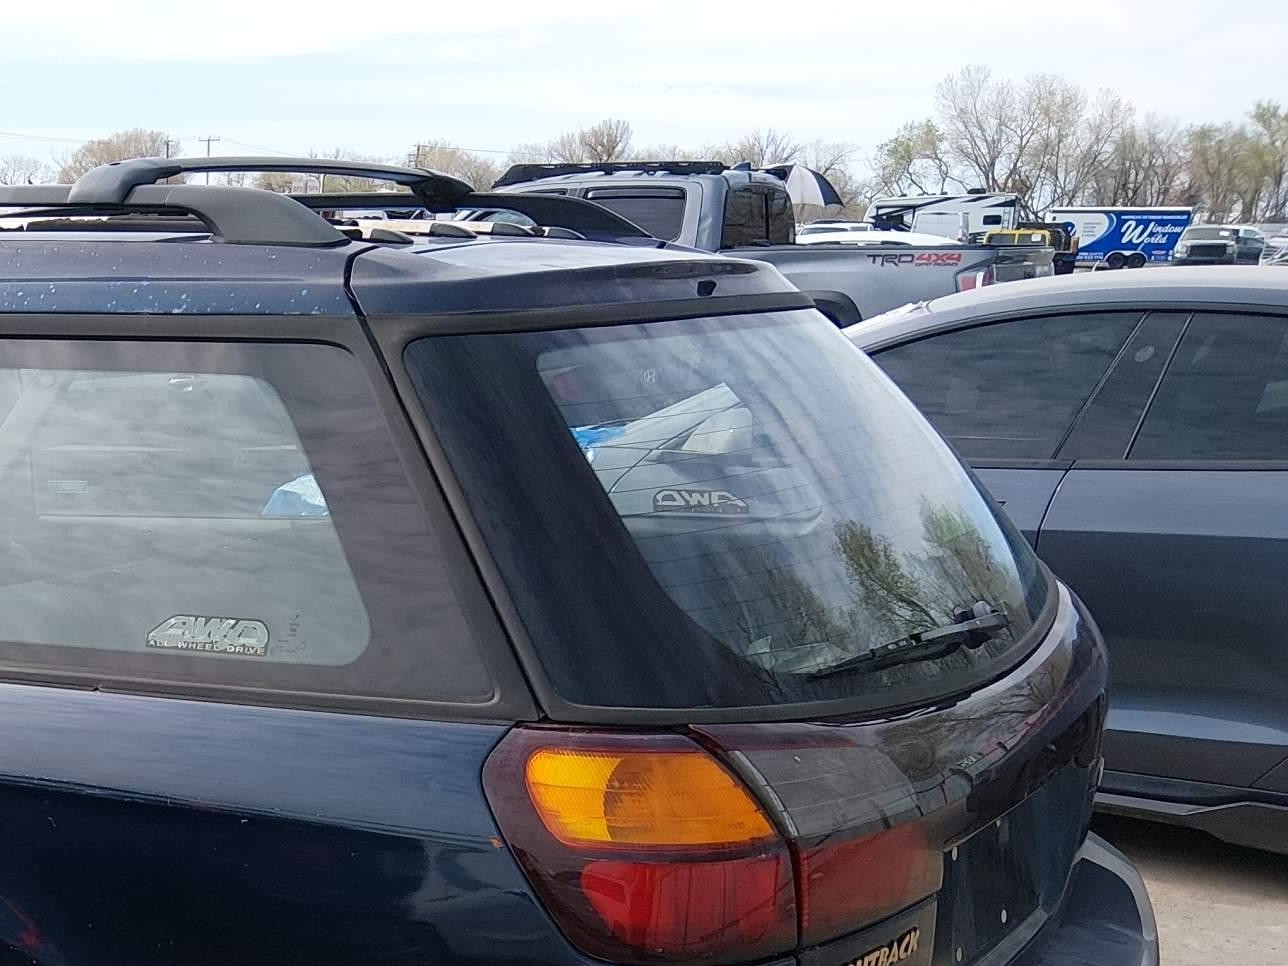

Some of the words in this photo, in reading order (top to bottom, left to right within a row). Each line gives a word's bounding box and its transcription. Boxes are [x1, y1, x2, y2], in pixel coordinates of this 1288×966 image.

[1121, 220, 1184, 244] Window
[866, 254, 914, 267] TRD
[149, 640, 173, 648] ALL
[177, 641, 219, 651] WHEEL
[226, 645, 265, 655] DRIVE
